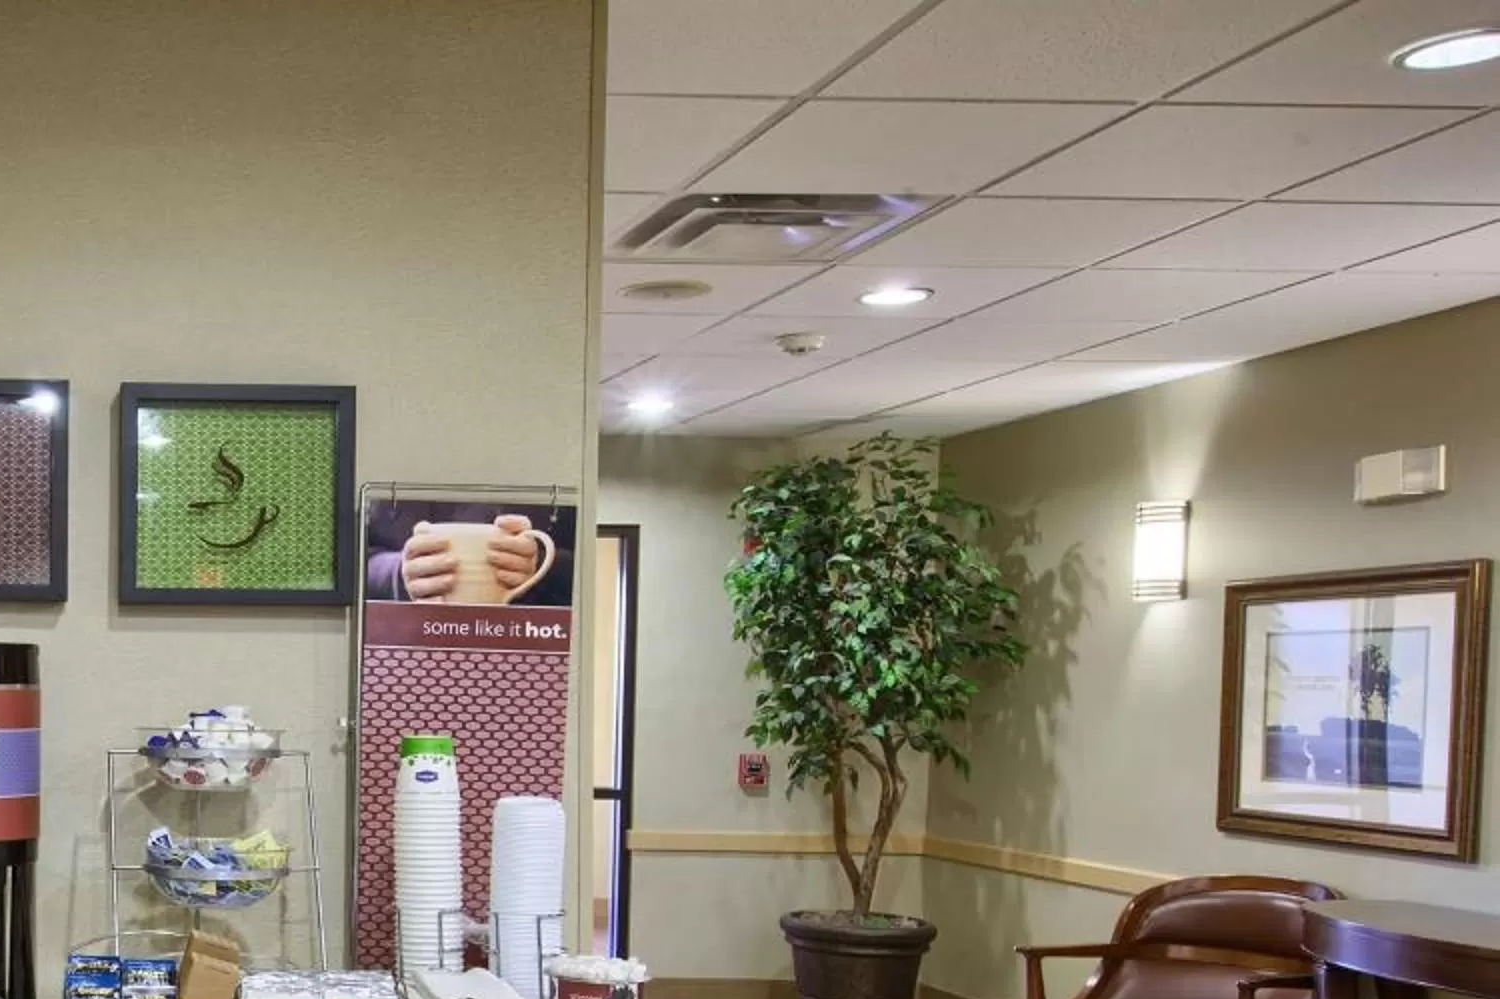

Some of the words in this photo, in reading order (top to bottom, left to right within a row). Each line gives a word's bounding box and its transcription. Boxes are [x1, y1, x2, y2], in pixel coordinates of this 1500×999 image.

[423, 621, 469, 636] some
[475, 619, 505, 637] like
[509, 620, 521, 637] it
[525, 622, 568, 639] hot.
